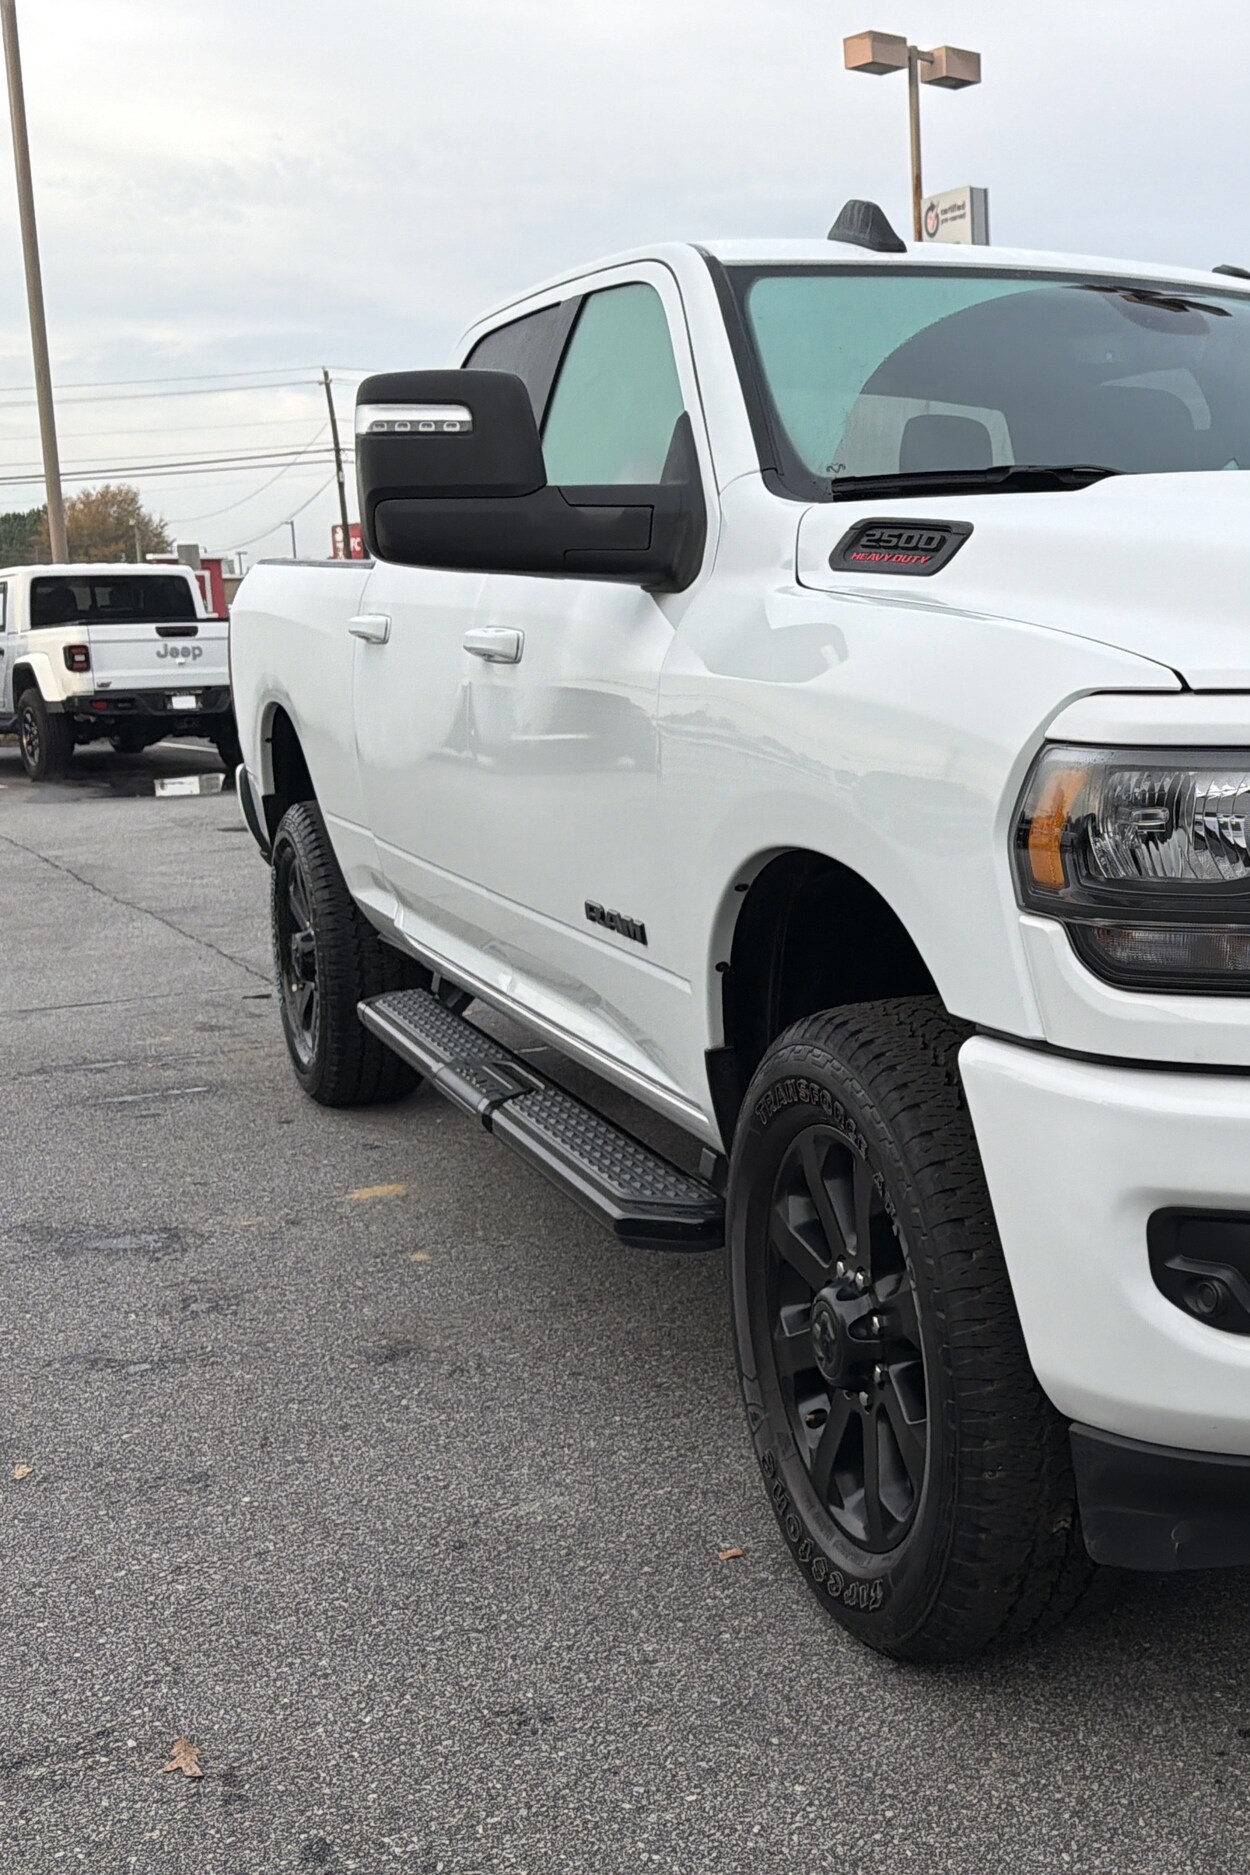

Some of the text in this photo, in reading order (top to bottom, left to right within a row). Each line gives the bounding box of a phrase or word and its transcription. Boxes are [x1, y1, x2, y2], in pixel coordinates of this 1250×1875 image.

[940, 201, 966, 216] certified
[860, 530, 946, 551] 2500
[850, 552, 934, 565] HEAVY DUTY
[156, 643, 203, 661] Jeep
[584, 899, 648, 946] RAM
